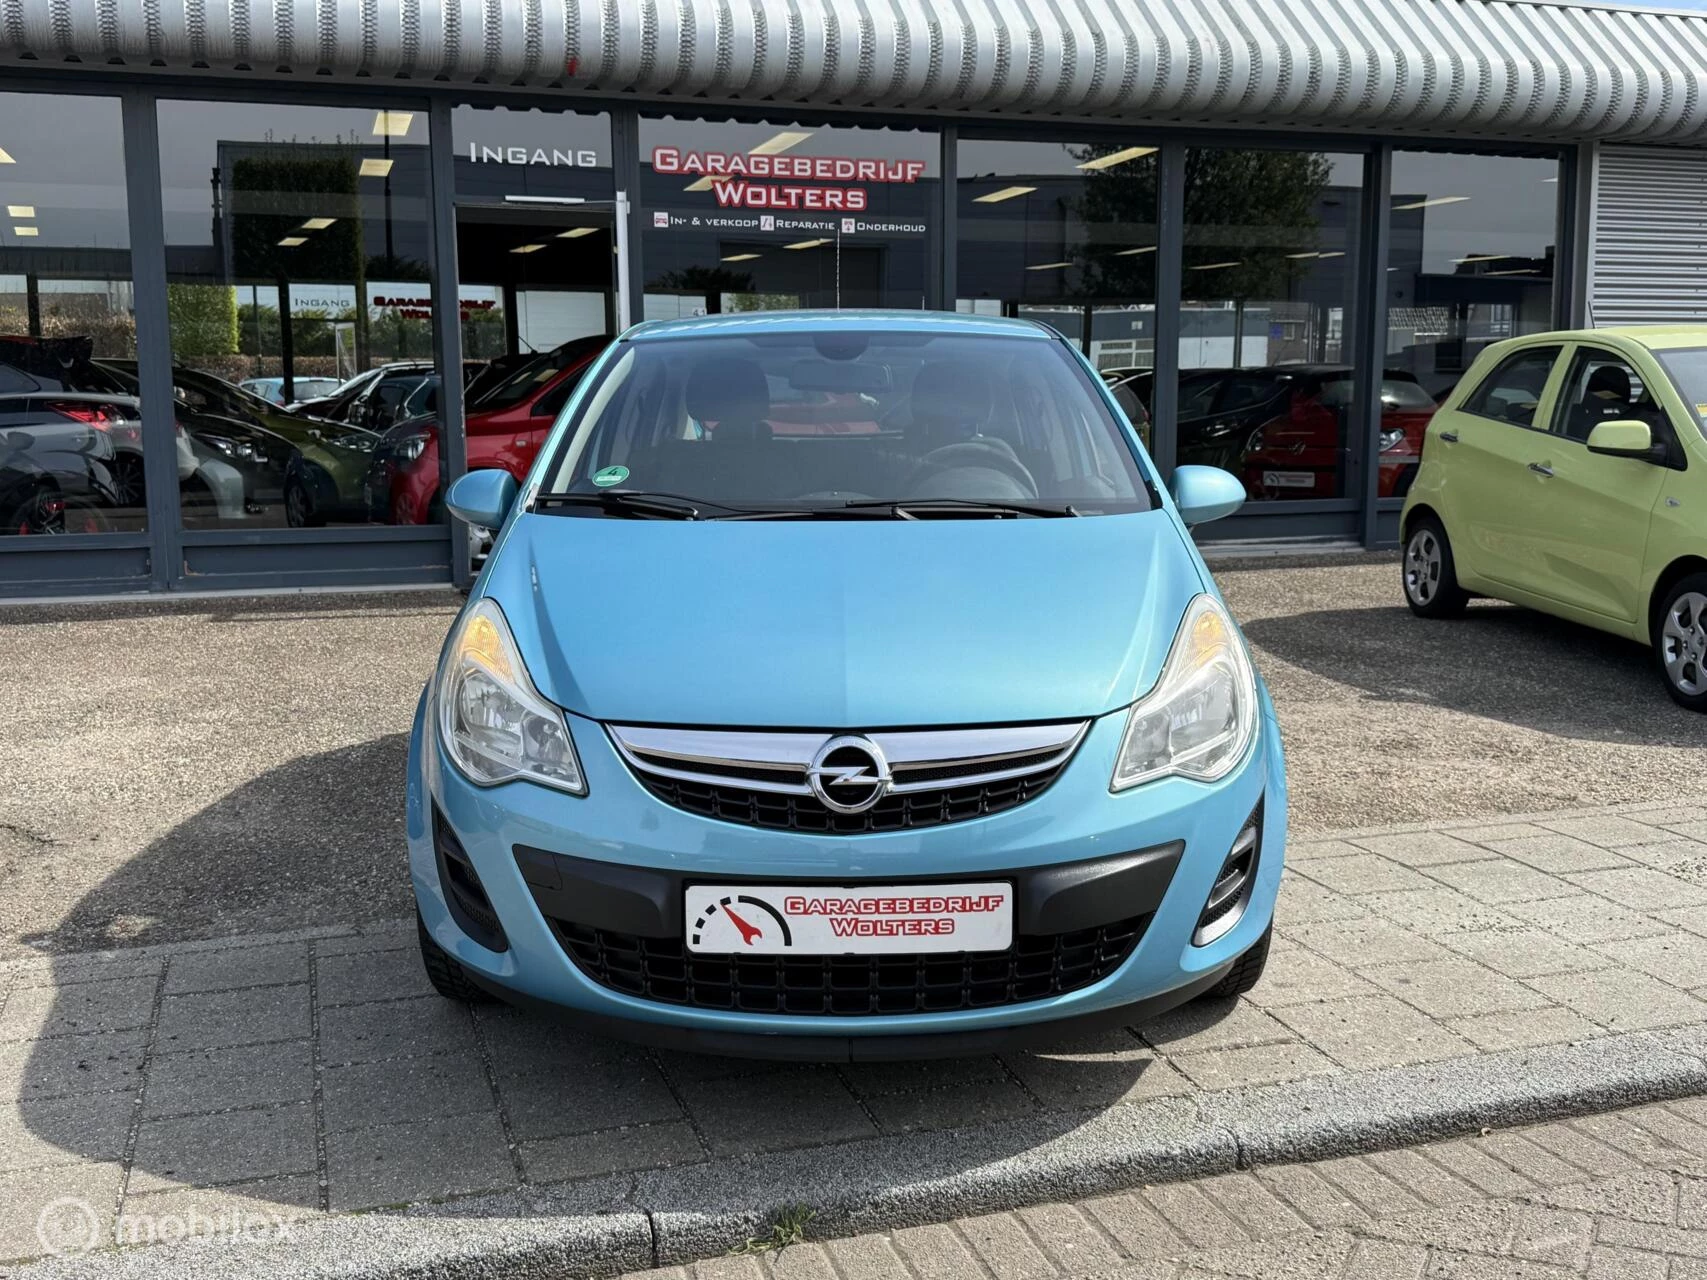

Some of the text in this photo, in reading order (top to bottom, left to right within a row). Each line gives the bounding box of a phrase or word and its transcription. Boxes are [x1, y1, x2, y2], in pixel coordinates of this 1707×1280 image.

[469, 142, 597, 168] INGANG
[652, 145, 926, 183] GARAGEBEDRIJF
[711, 179, 867, 211] WOLTERS
[705, 218, 758, 228] VERKOOP
[776, 219, 835, 230] REPARATIE
[856, 222, 926, 232] ONDERHOUD
[784, 895, 1004, 915] GARAGEBEDRIJF
[830, 918, 956, 937] WOLTERS
